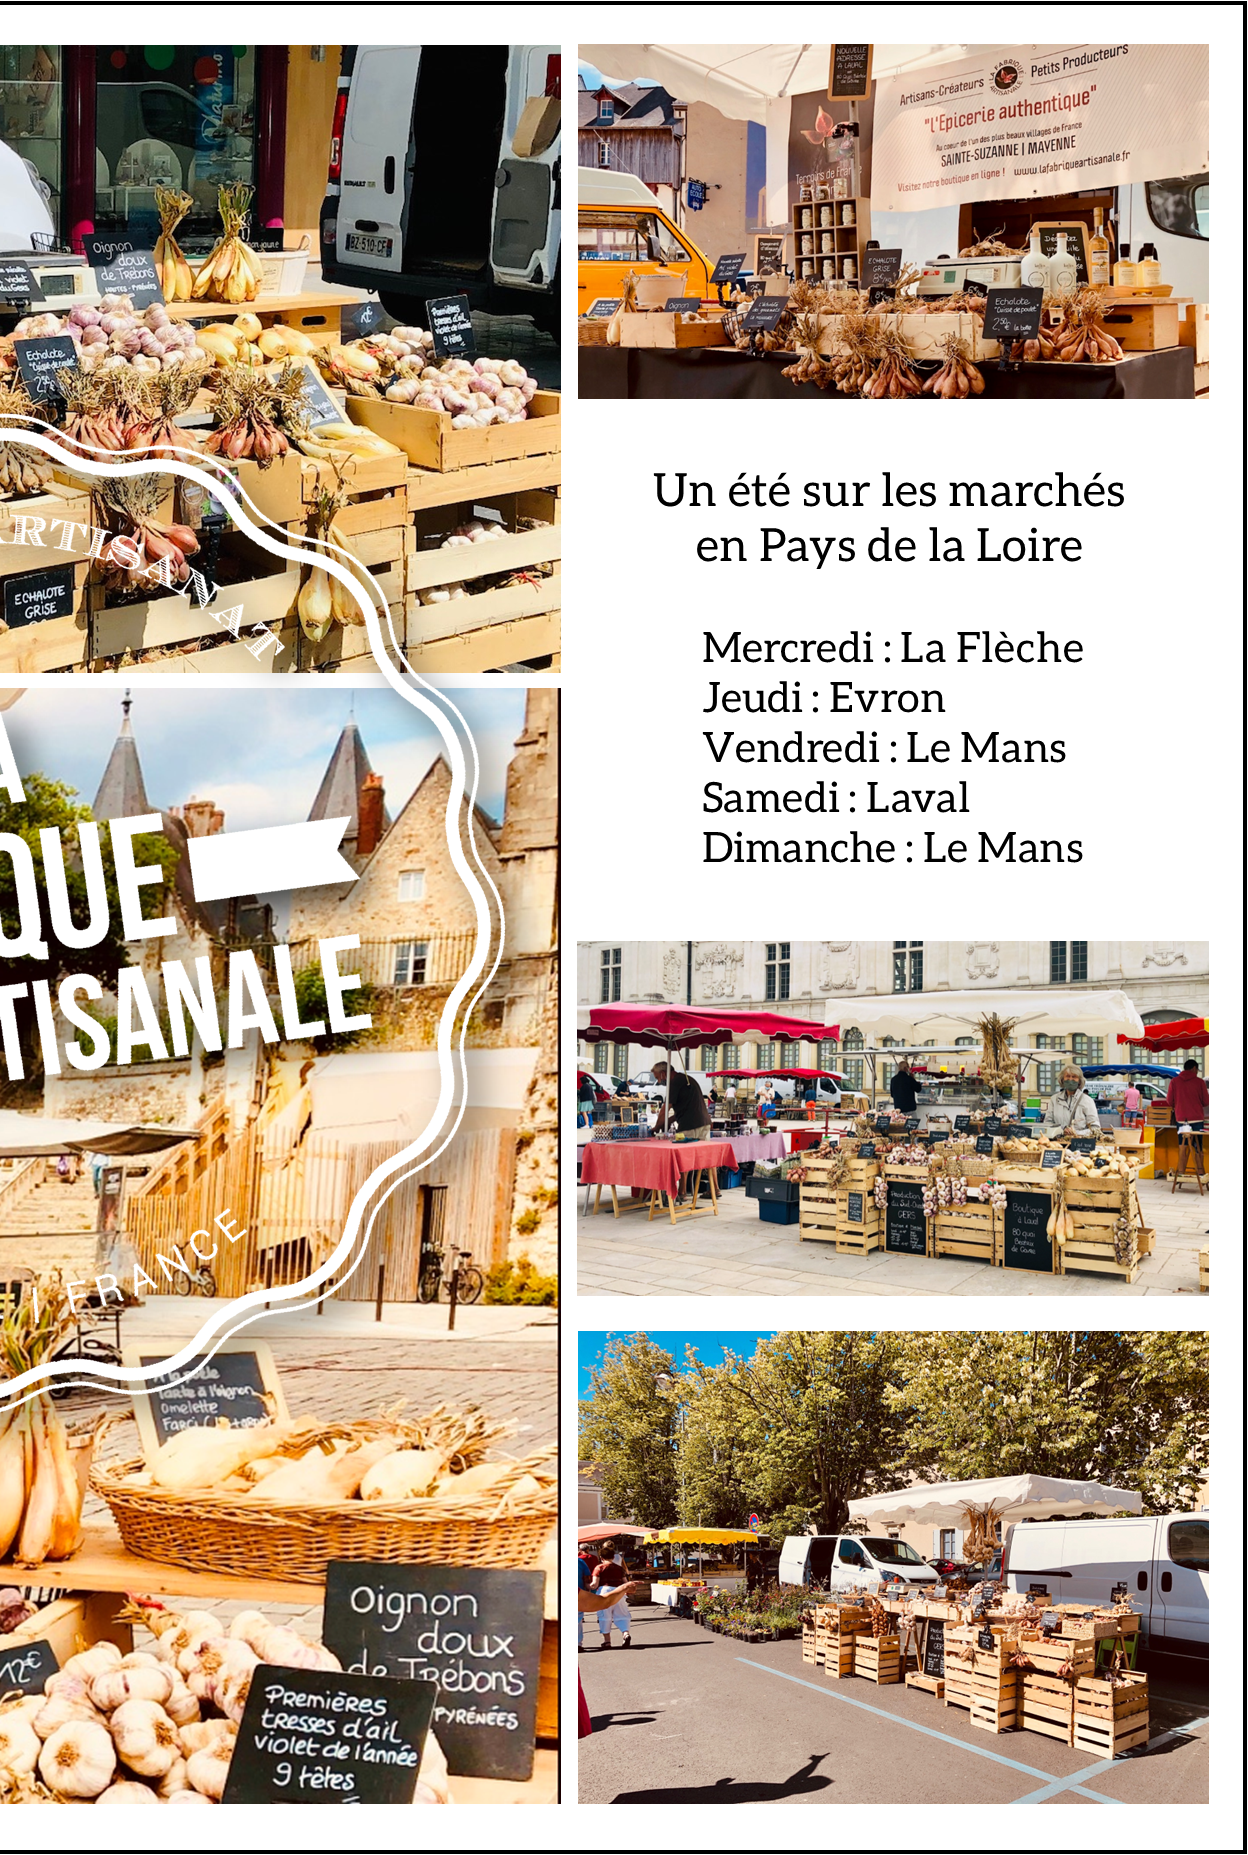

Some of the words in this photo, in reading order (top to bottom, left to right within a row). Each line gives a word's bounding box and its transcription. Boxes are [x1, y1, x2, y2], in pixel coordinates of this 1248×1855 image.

[900, 78, 984, 106] Artisans-Créateurs
[1031, 62, 1060, 78] Petits
[1062, 44, 1129, 70] Producteurs
[999, 84, 1097, 120] authentique"
[941, 144, 1019, 167] SAINTE-SUZANNE
[1028, 135, 1077, 155] MAYENNE
[959, 140, 967, 149] de
[980, 135, 990, 144] des
[991, 134, 1005, 144] plus
[1006, 130, 1025, 140] beaux
[1026, 127, 1052, 139] villages
[1052, 126, 1060, 134] de
[1061, 122, 1082, 132] France
[897, 182, 921, 192] Visitez
[922, 179, 940, 190] notre
[941, 174, 970, 187] boutique
[971, 173, 979, 181] en
[980, 170, 1001, 182] ligne
[1014, 150, 1131, 176] www.lafabriqueartisanale.fr
[92, 241, 133, 260] Oignon
[118, 253, 148, 266] doux
[101, 267, 117, 281] de
[14, 585, 66, 606] ECHALOTE
[351, 1585, 477, 1632] Oignon
[418, 1619, 514, 1659] doux
[264, 1684, 388, 1717] Premières
[261, 1708, 336, 1736] tresses
[342, 1716, 403, 1745] d'ail
[254, 1732, 321, 1758] violet
[322, 1736, 350, 1760] de
[354, 1740, 419, 1768] l'année
[273, 1761, 292, 1788] 9
[298, 1765, 355, 1791] têtes
